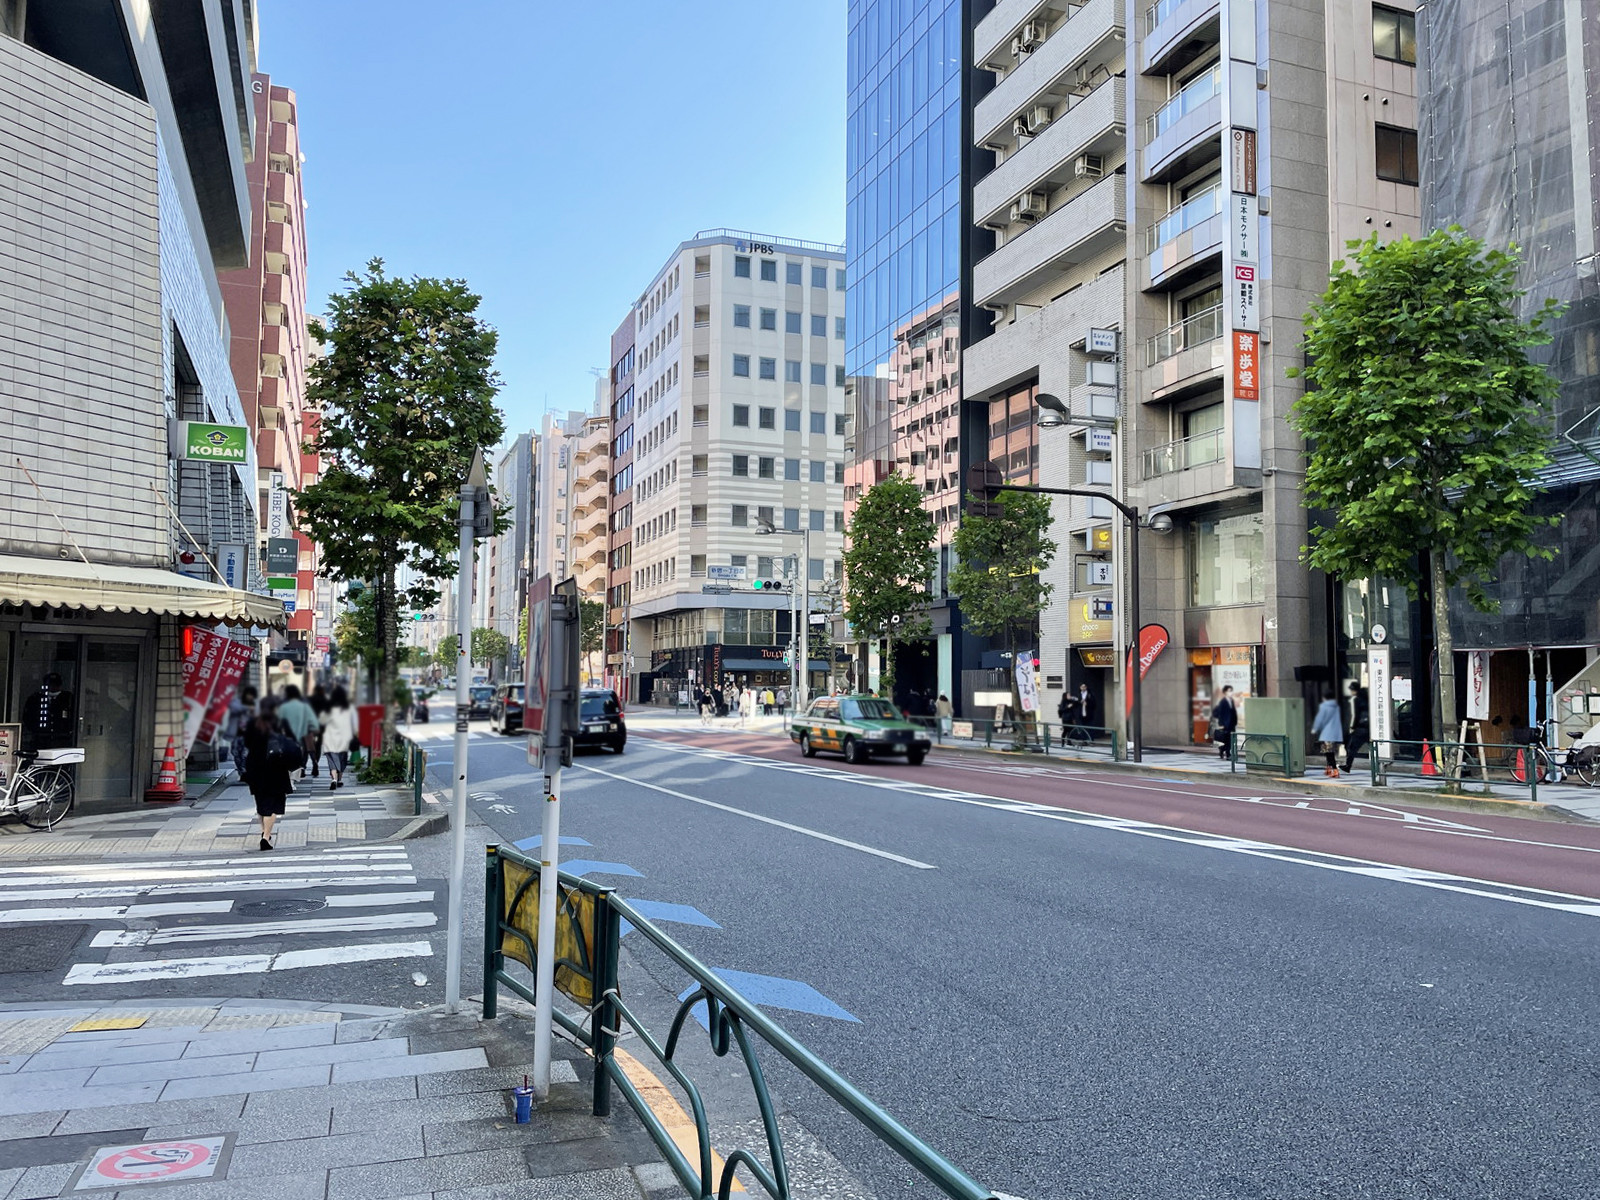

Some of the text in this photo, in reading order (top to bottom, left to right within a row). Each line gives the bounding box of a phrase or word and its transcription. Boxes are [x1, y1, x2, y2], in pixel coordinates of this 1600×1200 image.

[749, 242, 774, 255] JPBS
[1236, 268, 1253, 279] KS
[1239, 334, 1254, 388] 楽歩堂
[190, 445, 244, 459] KOBAN
[271, 514, 281, 539] KOGY
[761, 649, 783, 660] TULLY
[1095, 653, 1114, 662] choco
